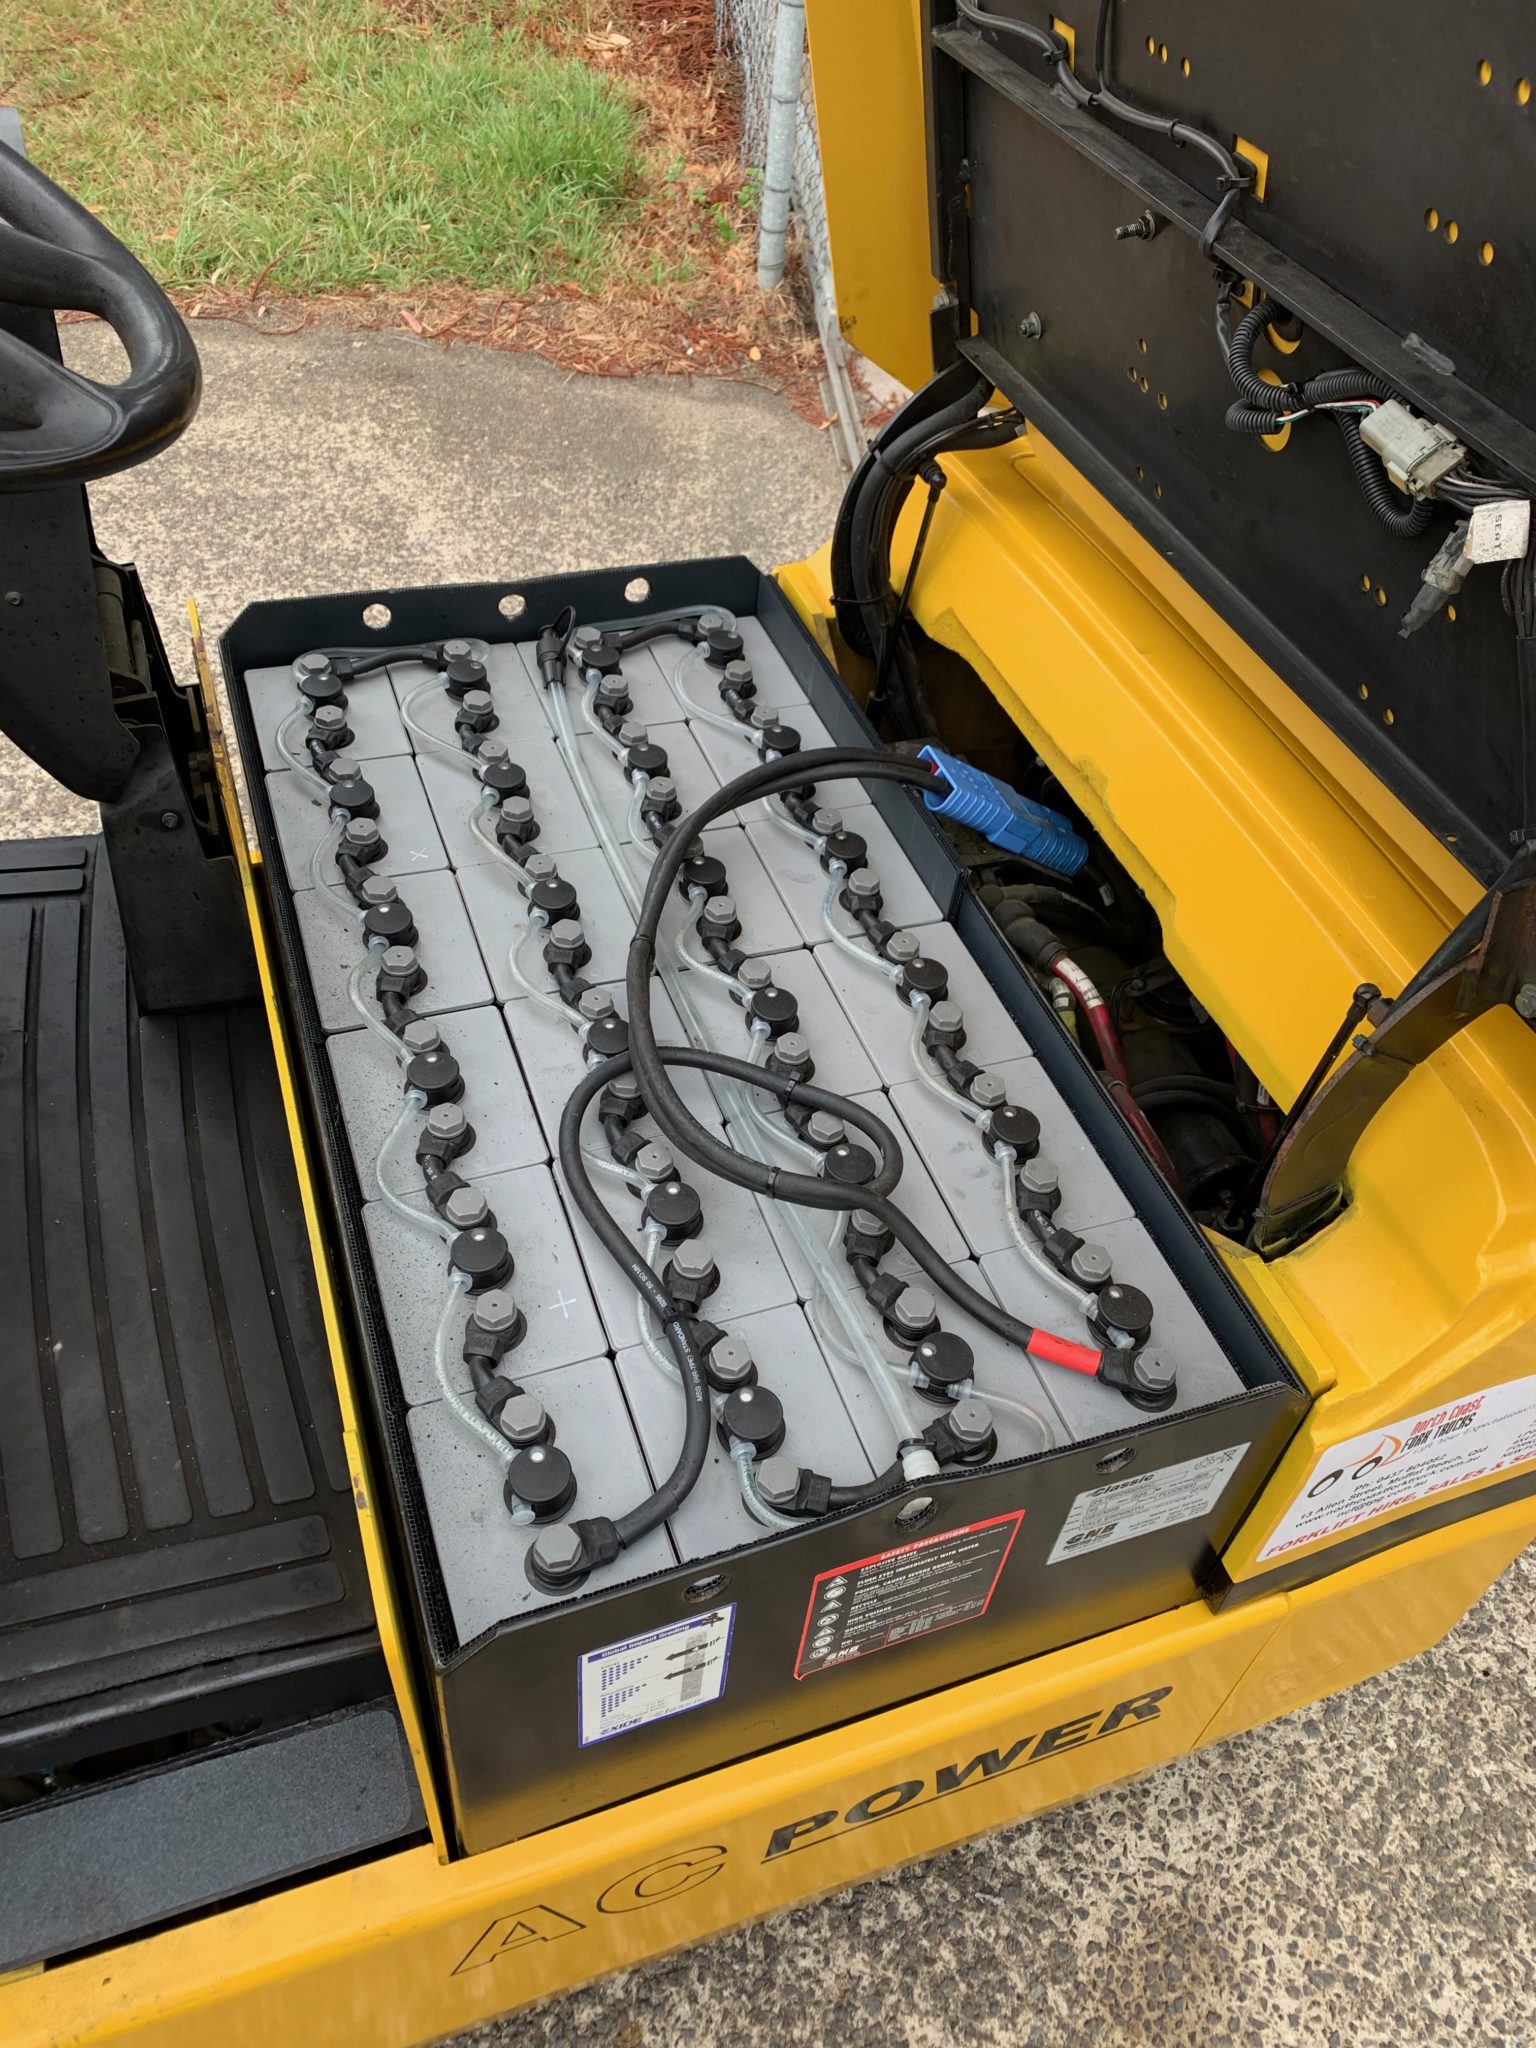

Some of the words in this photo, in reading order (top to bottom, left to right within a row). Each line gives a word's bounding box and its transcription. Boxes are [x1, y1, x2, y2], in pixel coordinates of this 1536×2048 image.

[673, 1321, 691, 1353] STANDARD
[1400, 1429, 1433, 1453] FORK
[1433, 1412, 1476, 1440] TRUCKS
[1090, 1474, 1155, 1497] Classic
[1301, 1511, 1313, 1521] 13
[1316, 1499, 1345, 1513] Allen
[1388, 1469, 1425, 1485] Moffat
[1468, 1445, 1488, 1457] Qld
[1266, 1512, 1366, 1557] FORKLIFT
[1424, 1467, 1487, 1495] SALES
[1489, 1461, 1505, 1472] &
[880, 1545, 911, 1561] SAFETY
[913, 1527, 970, 1549] PRECAUTIONS
[1065, 1522, 1119, 1545] GNB
[860, 1557, 896, 1573] EXPLOSIVE
[879, 1570, 894, 1579] EYES
[895, 1555, 938, 1572] IMMEDIATELY
[939, 1550, 957, 1559] WITH
[958, 1542, 979, 1553] WATER
[907, 1567, 931, 1578] SEVERE
[865, 1606, 892, 1617] VOLTAGE
[601, 1643, 628, 1658] Global
[628, 1635, 658, 1649] Impact
[659, 1625, 690, 1639] Grading
[600, 1716, 643, 1736] EXIDE
[450, 1844, 728, 1977] AC
[763, 1685, 1174, 1861] POWER
